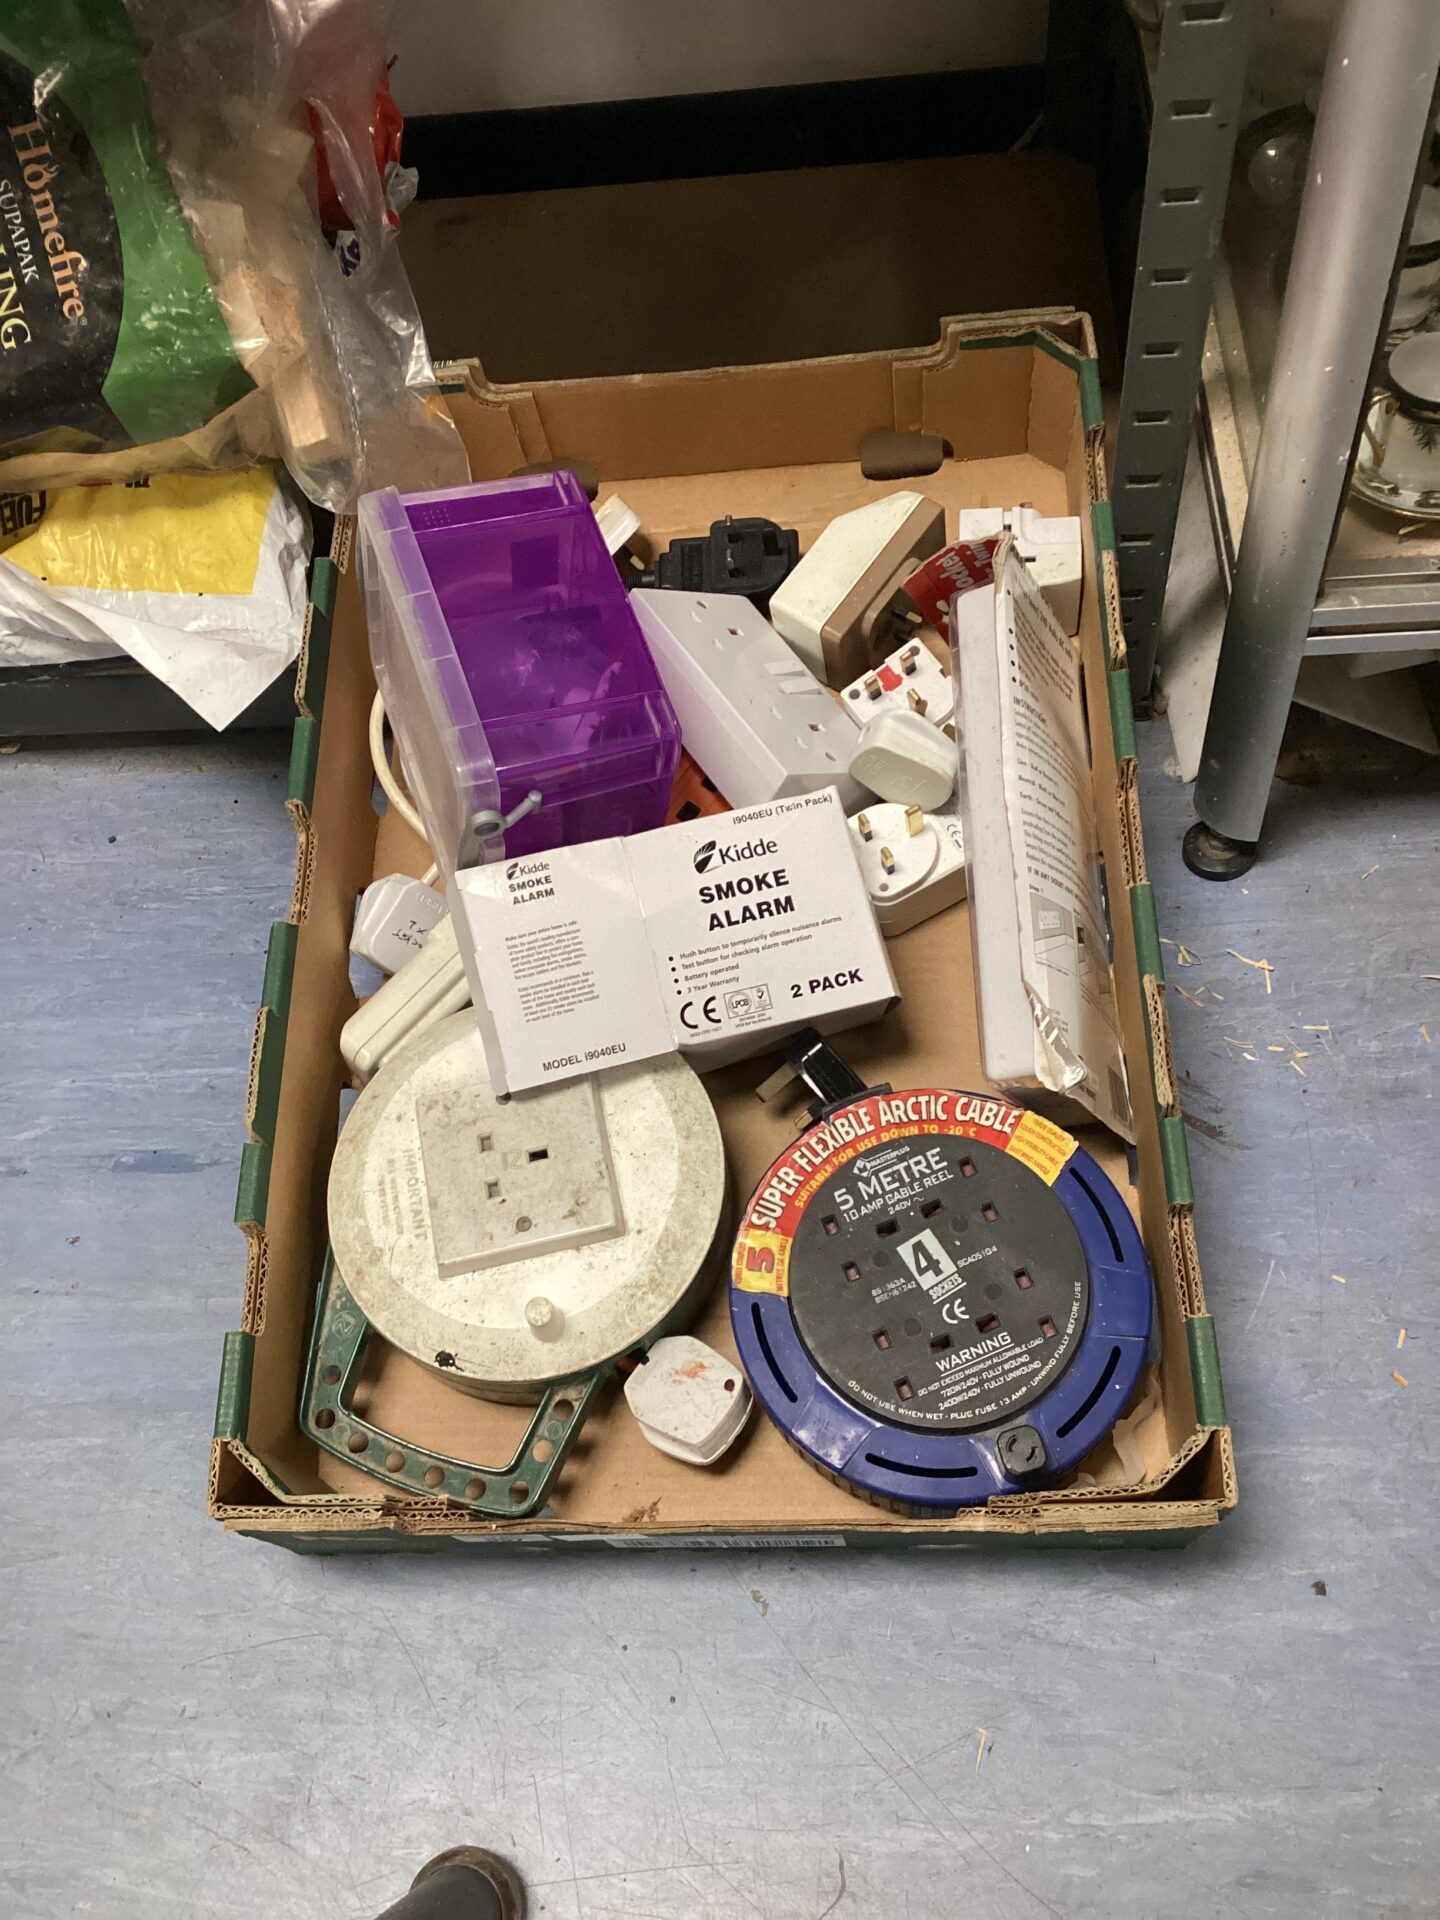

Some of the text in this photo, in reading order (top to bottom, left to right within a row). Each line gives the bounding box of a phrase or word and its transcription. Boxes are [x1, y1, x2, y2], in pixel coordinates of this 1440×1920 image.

[0, 179, 39, 285] SUPAPAK
[7, 118, 87, 319] Homefire
[935, 551, 975, 588] ocket
[775, 801, 803, 816] (Twin
[805, 794, 833, 807] Pack)
[718, 838, 779, 865] Kidde
[508, 874, 553, 893] SMOKE
[519, 862, 550, 877] Kidde
[699, 868, 790, 904] SMOKE
[513, 887, 555, 905] ALARM
[708, 895, 795, 932] ALARM
[680, 915, 843, 960] Hush button to temporarily silence nuisance alarms
[681, 933, 813, 971] Test button for checking alarm operation
[684, 963, 740, 983] Battery operated
[687, 975, 740, 995] 3 Year Warranty
[790, 968, 864, 999] 2 PACK
[542, 1054, 583, 1072] MODEL
[751, 1095, 1020, 1230] SUPER FLEXIBLE ARCTIC CABLE
[795, 1163, 833, 1209] SUITABLE
[832, 1147, 856, 1166] FOR
[856, 1135, 878, 1152] USE
[880, 1124, 919, 1141] DOWN
[922, 1124, 939, 1135] TO
[943, 1125, 964, 1136] -20
[871, 1146, 910, 1167] MASTERPLUG
[833, 1147, 948, 1211] 5 METRE
[843, 1170, 954, 1222] 10 AMP CABLE REEL
[888, 1199, 912, 1215] 240V
[746, 1246, 775, 1273] 5
[911, 1239, 944, 1277] 4
[929, 1273, 962, 1299] SOCKETS
[847, 1380, 860, 1392] DO
[860, 1389, 878, 1403] NOT
[879, 1400, 896, 1412] USE
[898, 1407, 924, 1419] WHEN
[925, 1412, 944, 1420] WET
[975, 1402, 998, 1415] FUSE
[999, 1397, 1010, 1406] 13
[1011, 1386, 1027, 1401] AMP
[1030, 1358, 1057, 1387] UNWIND
[1054, 1335, 1070, 1359] FULLY
[1066, 1300, 1080, 1335] BEFORE
[1074, 1281, 1082, 1299] USE
[918, 1337, 1044, 1397] DO NOT EXCEED MAXIMUM ALLOWABLE LOAD
[935, 1332, 1012, 1372] WARNING
[982, 1365, 1003, 1380] FULLY
[1003, 1354, 1030, 1370] WOUND
[983, 1376, 1005, 1390] FULLY
[1005, 1360, 1042, 1381] UNWOUND
